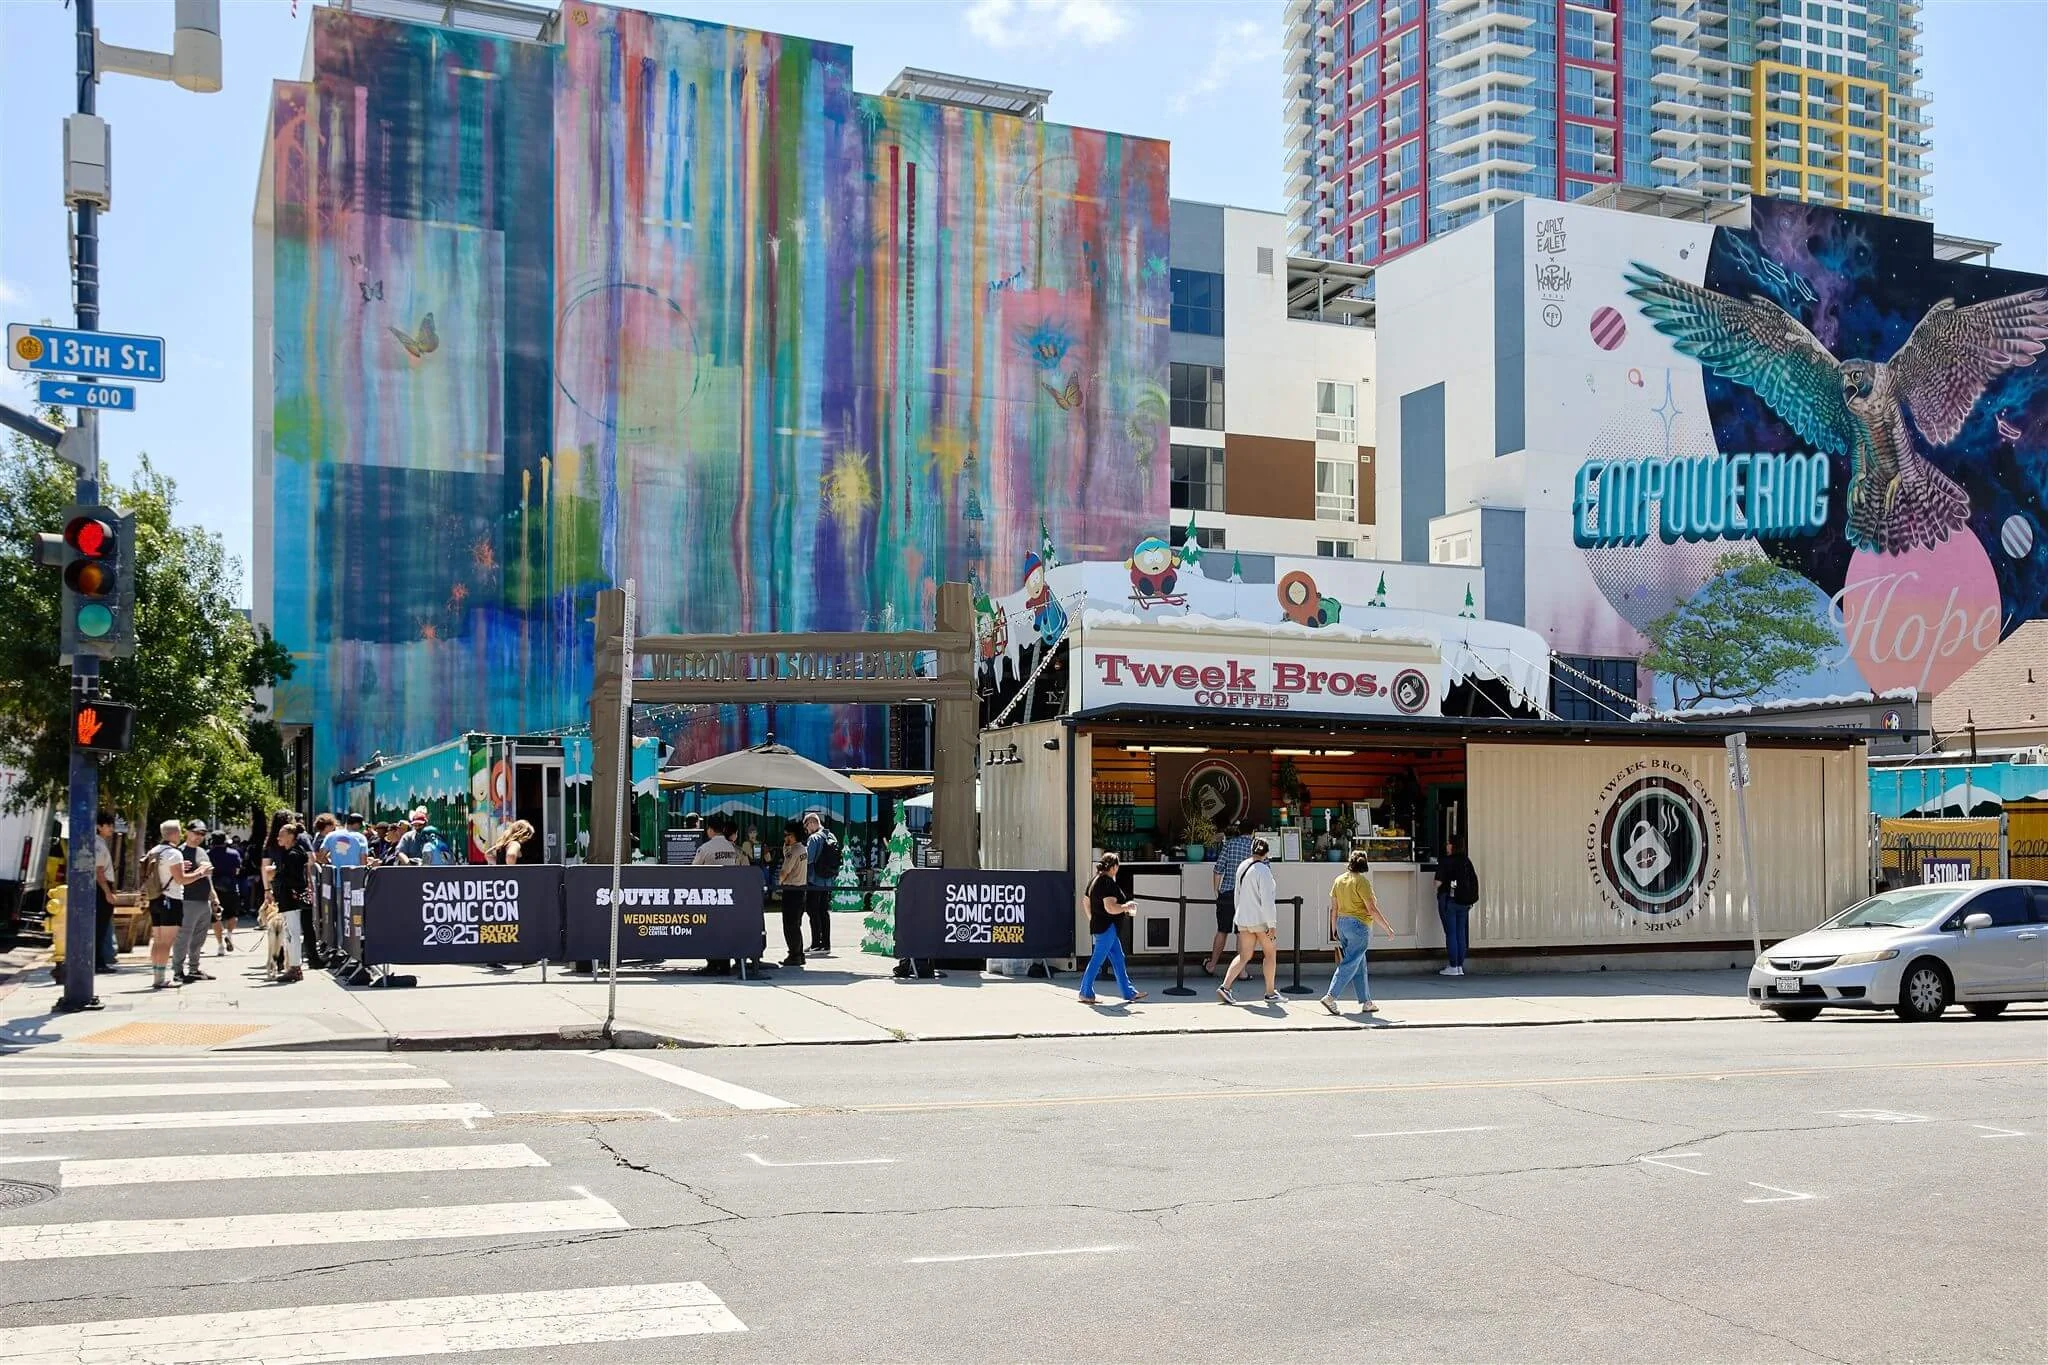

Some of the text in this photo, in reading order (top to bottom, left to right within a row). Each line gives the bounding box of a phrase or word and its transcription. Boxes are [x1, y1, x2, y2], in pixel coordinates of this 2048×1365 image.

[48, 337, 156, 372] 13TH ST.
[86, 387, 121, 406] 600
[1573, 452, 1830, 548] EMPOWERING
[1822, 571, 2013, 690] Hope
[652, 650, 916, 681] WELCOME TO SOUTH PARK
[1095, 653, 1388, 698] Tweek Bros.
[1195, 690, 1290, 709] COFFEE
[1599, 760, 1648, 802] TWEEK
[1651, 759, 1691, 782] BROS.
[1693, 779, 1722, 844] COFFEE
[1587, 823, 1625, 919] SAN DIEGO
[1923, 863, 1970, 883] U-STOR-IT
[422, 880, 519, 901] SAN DIEGO
[596, 888, 734, 906] SOUTH PARK
[946, 884, 1026, 903] SAN DIEGO
[422, 901, 519, 923] COMIC CON
[623, 914, 707, 924] WEDNESDAYS ON
[945, 903, 1025, 923] COMIC CON
[480, 924, 519, 933] SOUTH
[670, 925, 692, 936] 10PM
[992, 925, 1025, 934] SOUTH
[1645, 918, 1683, 932] PARK
[480, 933, 520, 943] PARK
[992, 933, 1025, 943] PARK
